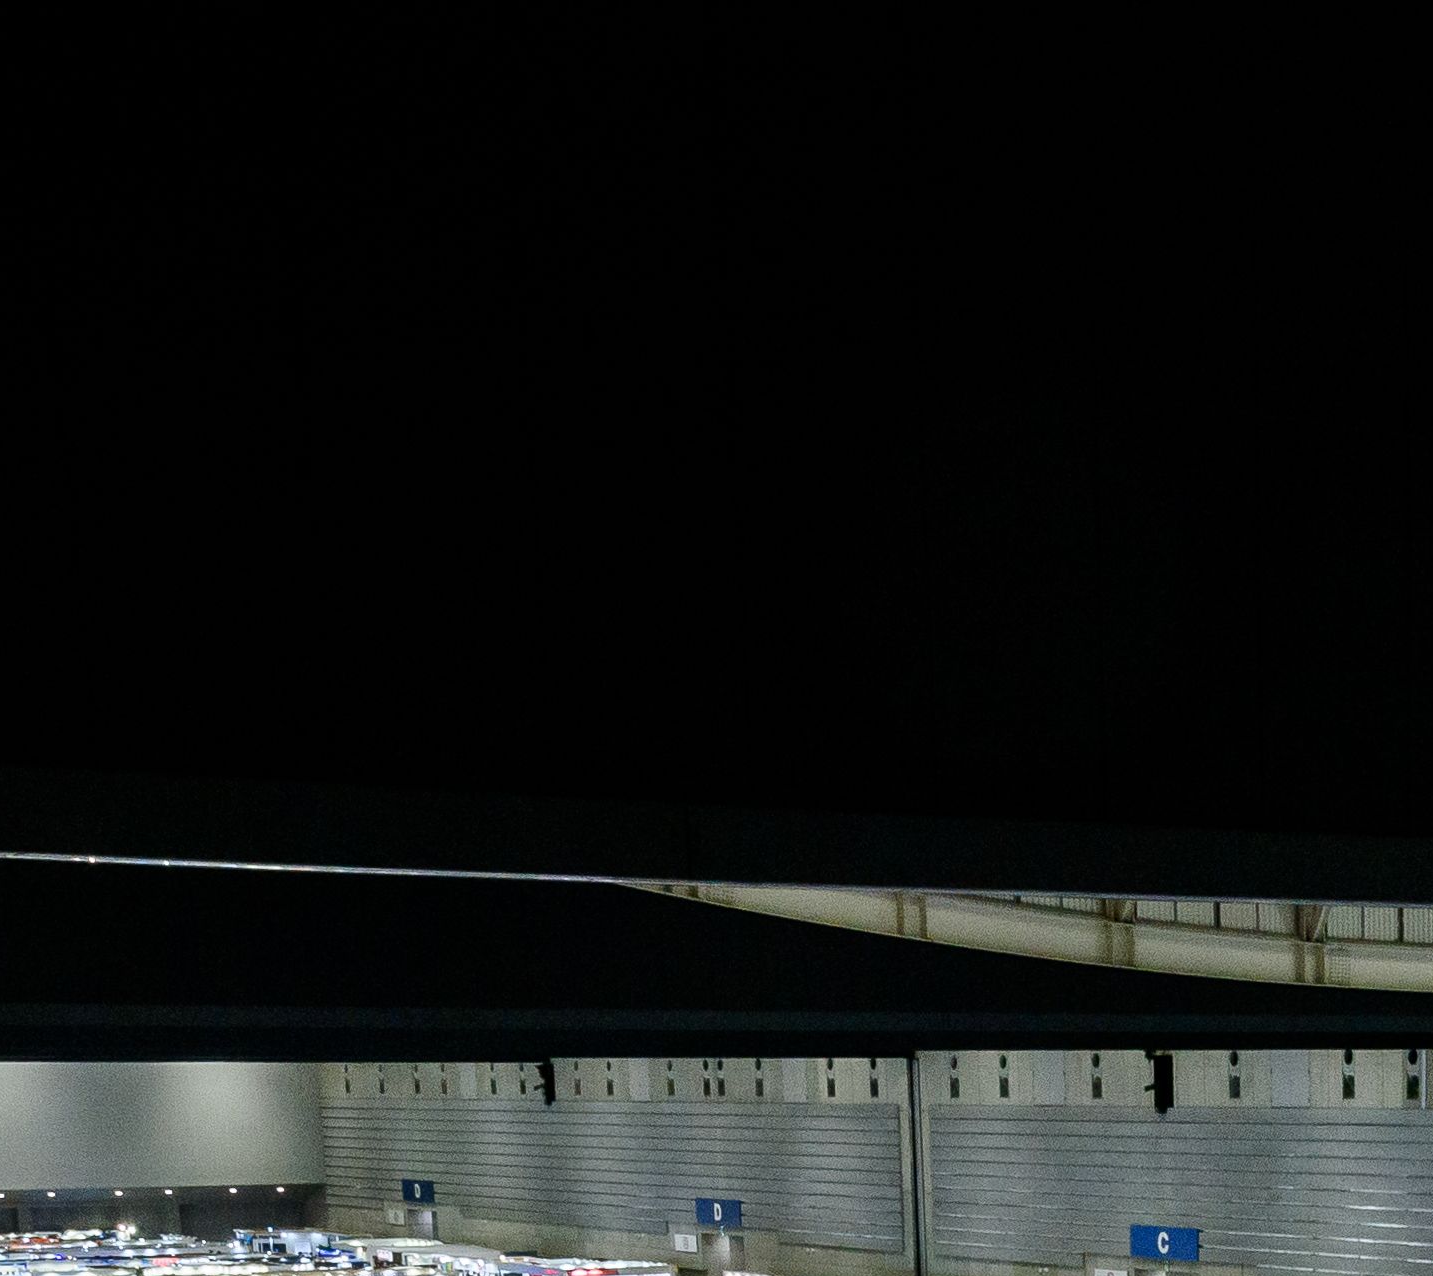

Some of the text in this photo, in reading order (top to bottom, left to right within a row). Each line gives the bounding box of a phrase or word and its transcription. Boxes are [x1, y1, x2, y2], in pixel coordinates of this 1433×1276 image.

[413, 1184, 422, 1198] D
[713, 1203, 723, 1220] D
[1157, 1232, 1169, 1253] C
